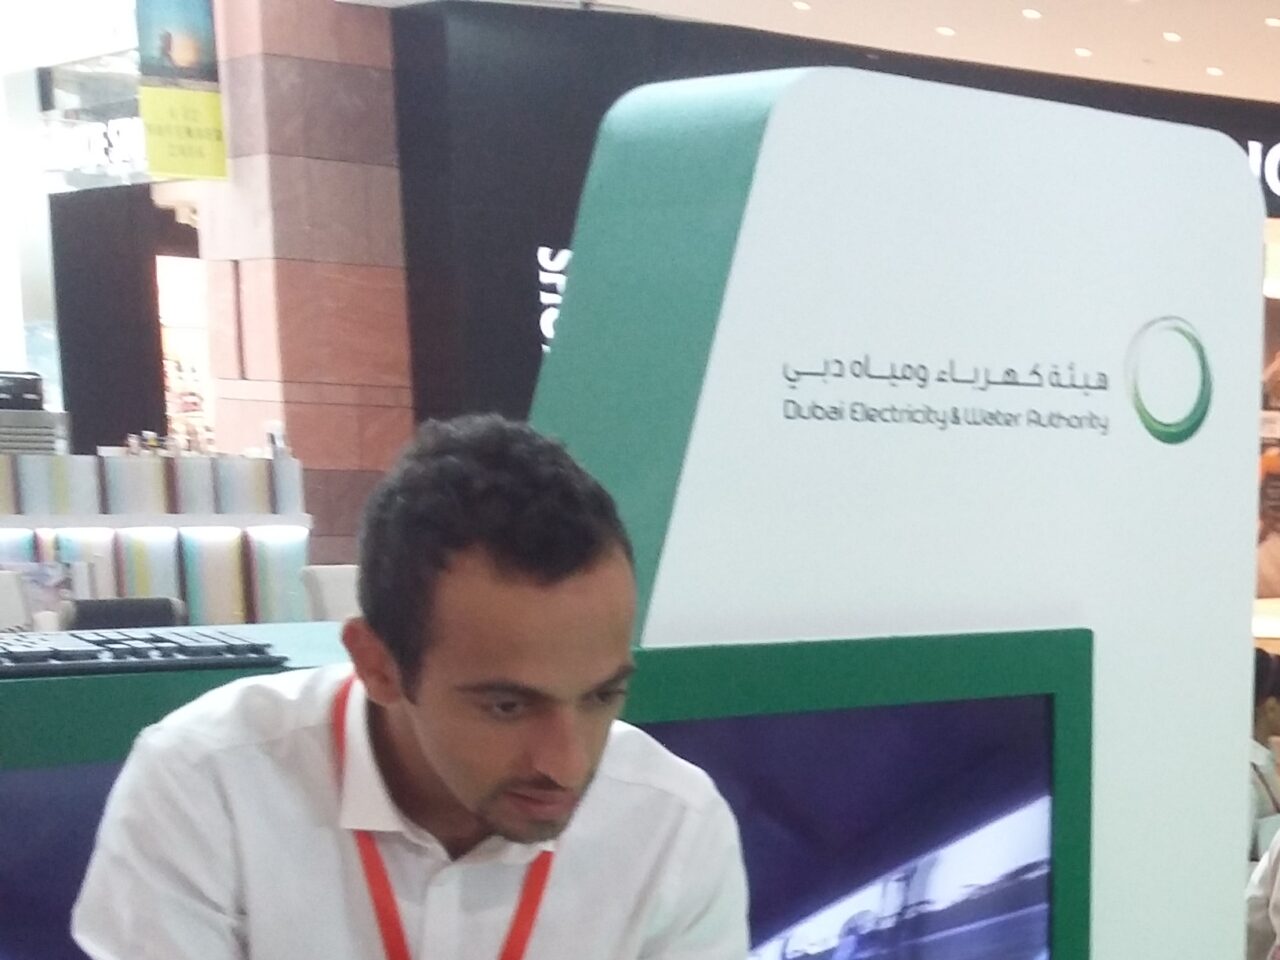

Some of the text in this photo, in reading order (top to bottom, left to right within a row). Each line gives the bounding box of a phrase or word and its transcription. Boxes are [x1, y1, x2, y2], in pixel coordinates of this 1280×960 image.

[783, 354, 1109, 396] هيئة كهرباء ومياه دبي
[783, 399, 844, 421] Dubai
[849, 402, 948, 430] Electricity
[963, 408, 1021, 427] Water
[1027, 409, 1110, 436] Authority
